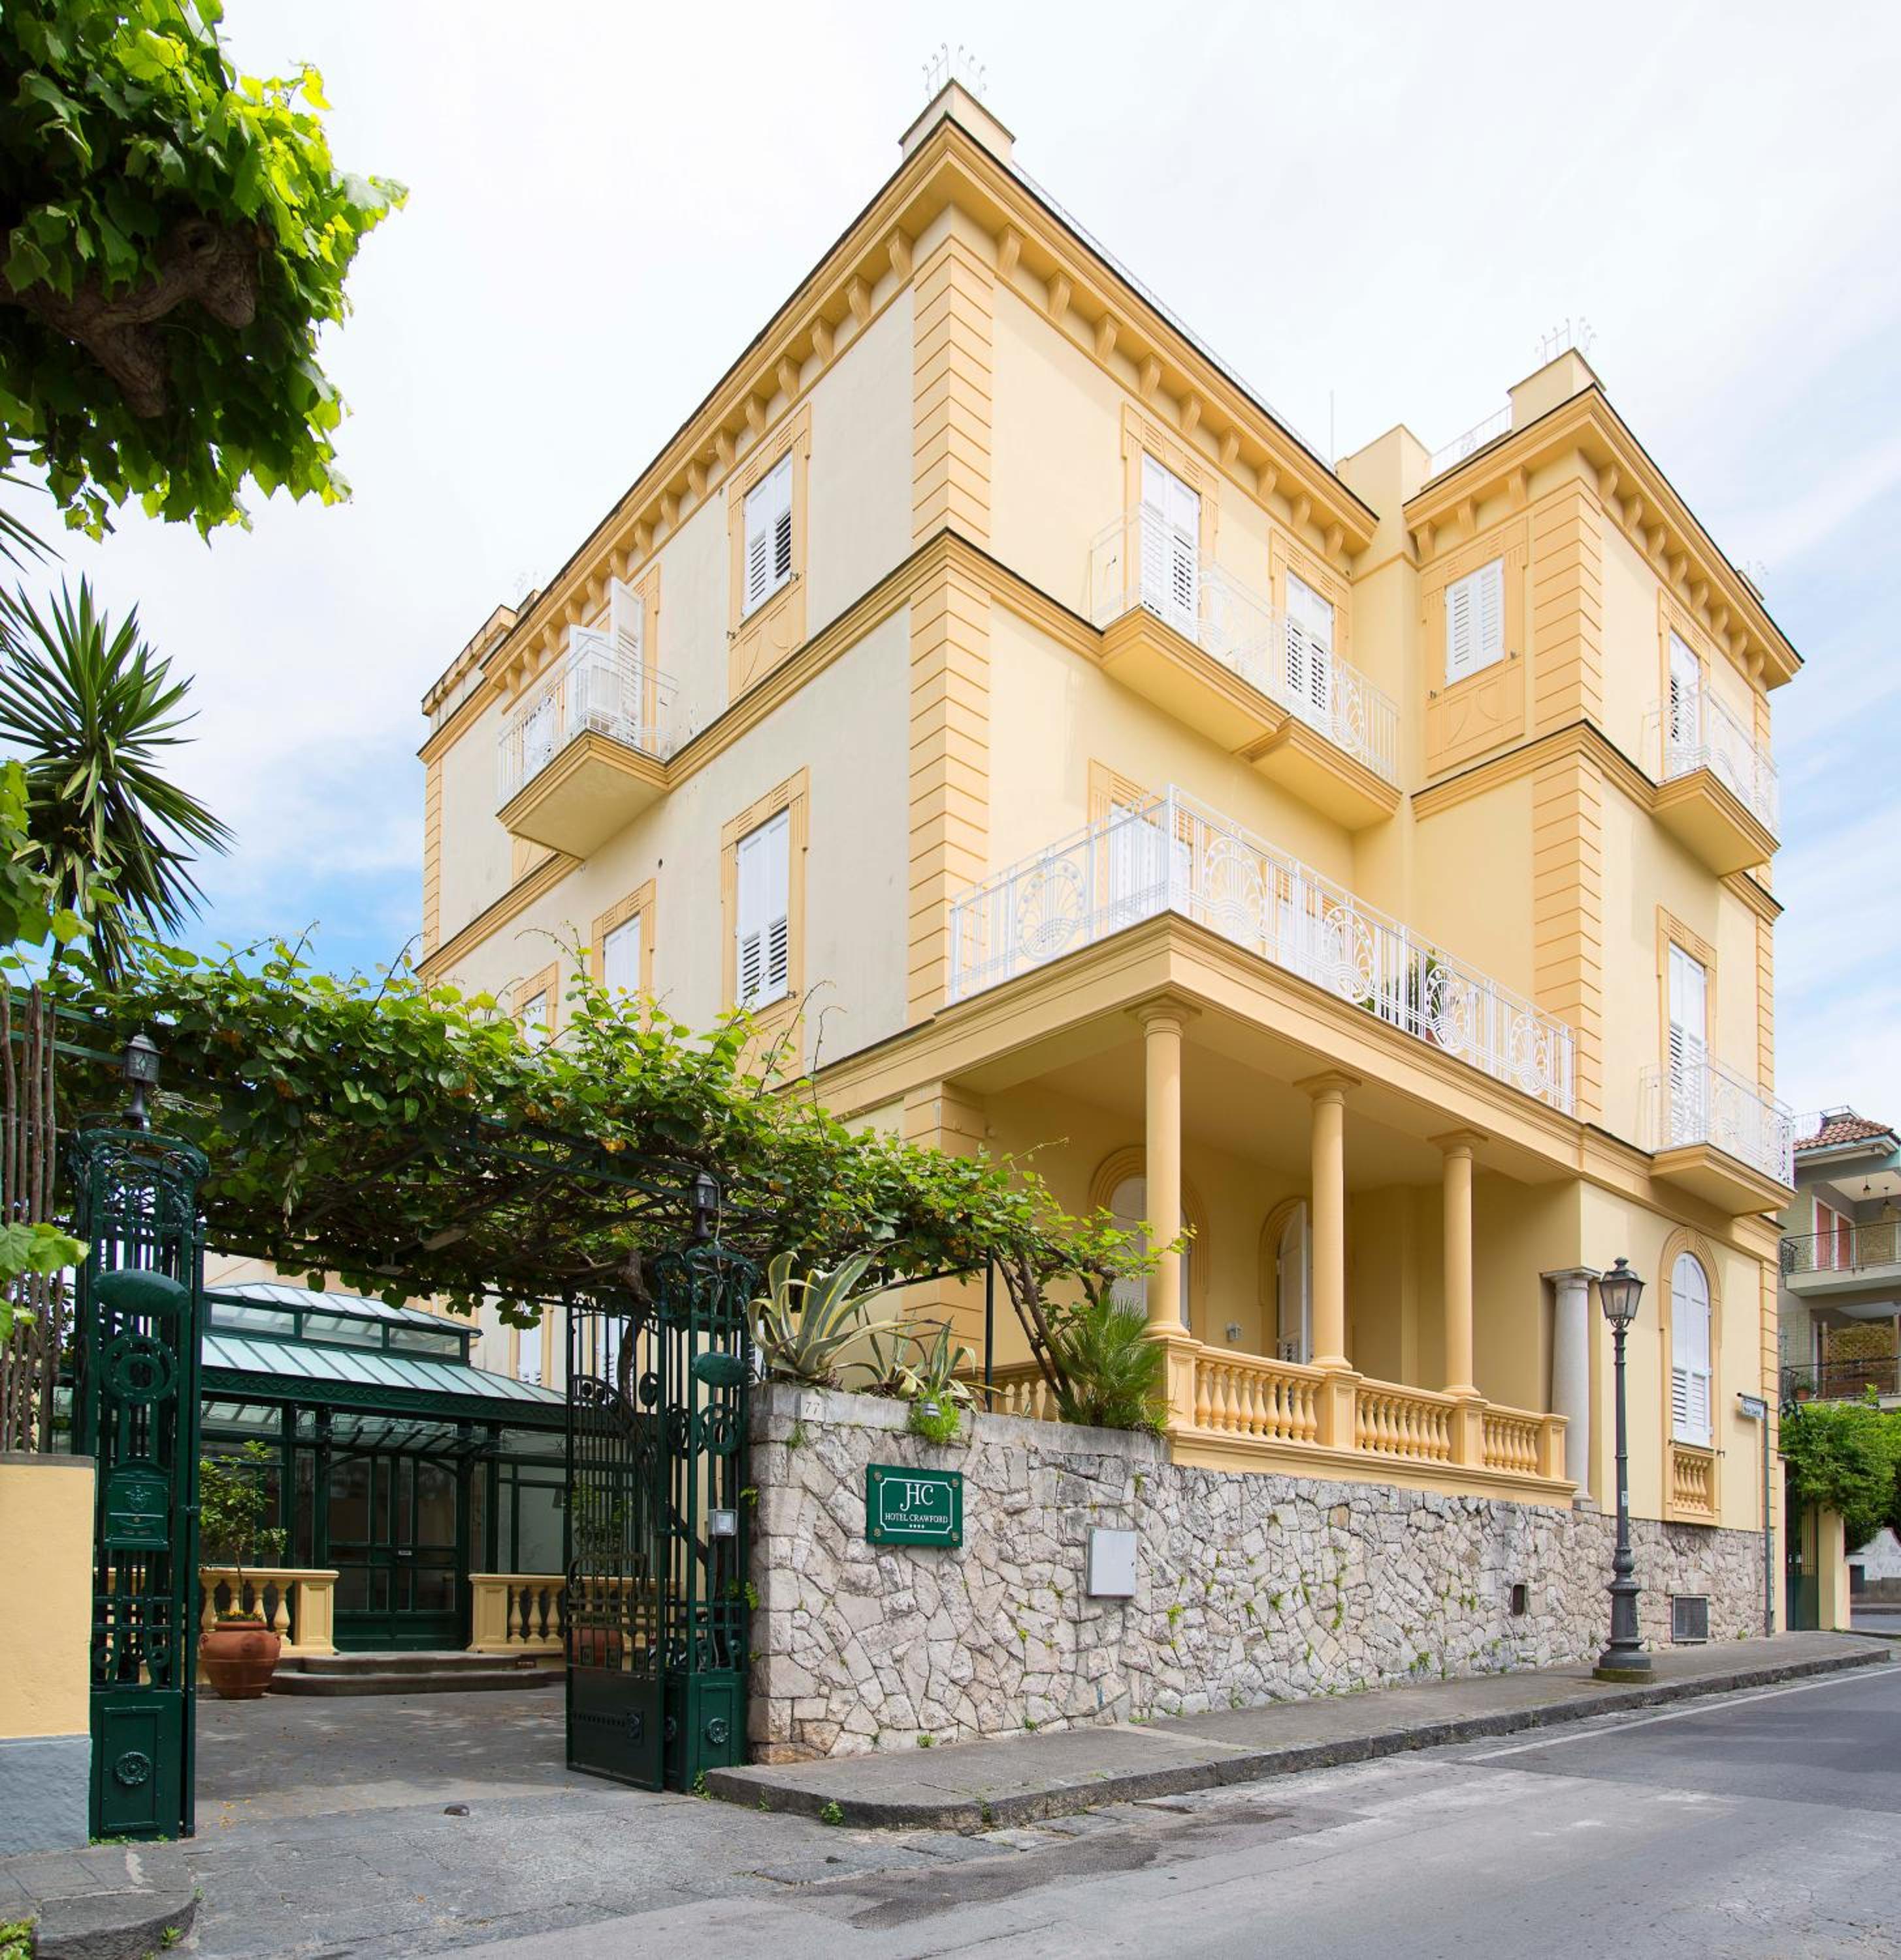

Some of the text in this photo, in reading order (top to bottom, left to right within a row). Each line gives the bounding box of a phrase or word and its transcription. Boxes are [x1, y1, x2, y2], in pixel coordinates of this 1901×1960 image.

[805, 1401, 820, 1414] 77
[885, 1512, 948, 1524] HOTEL CRAWFORD
